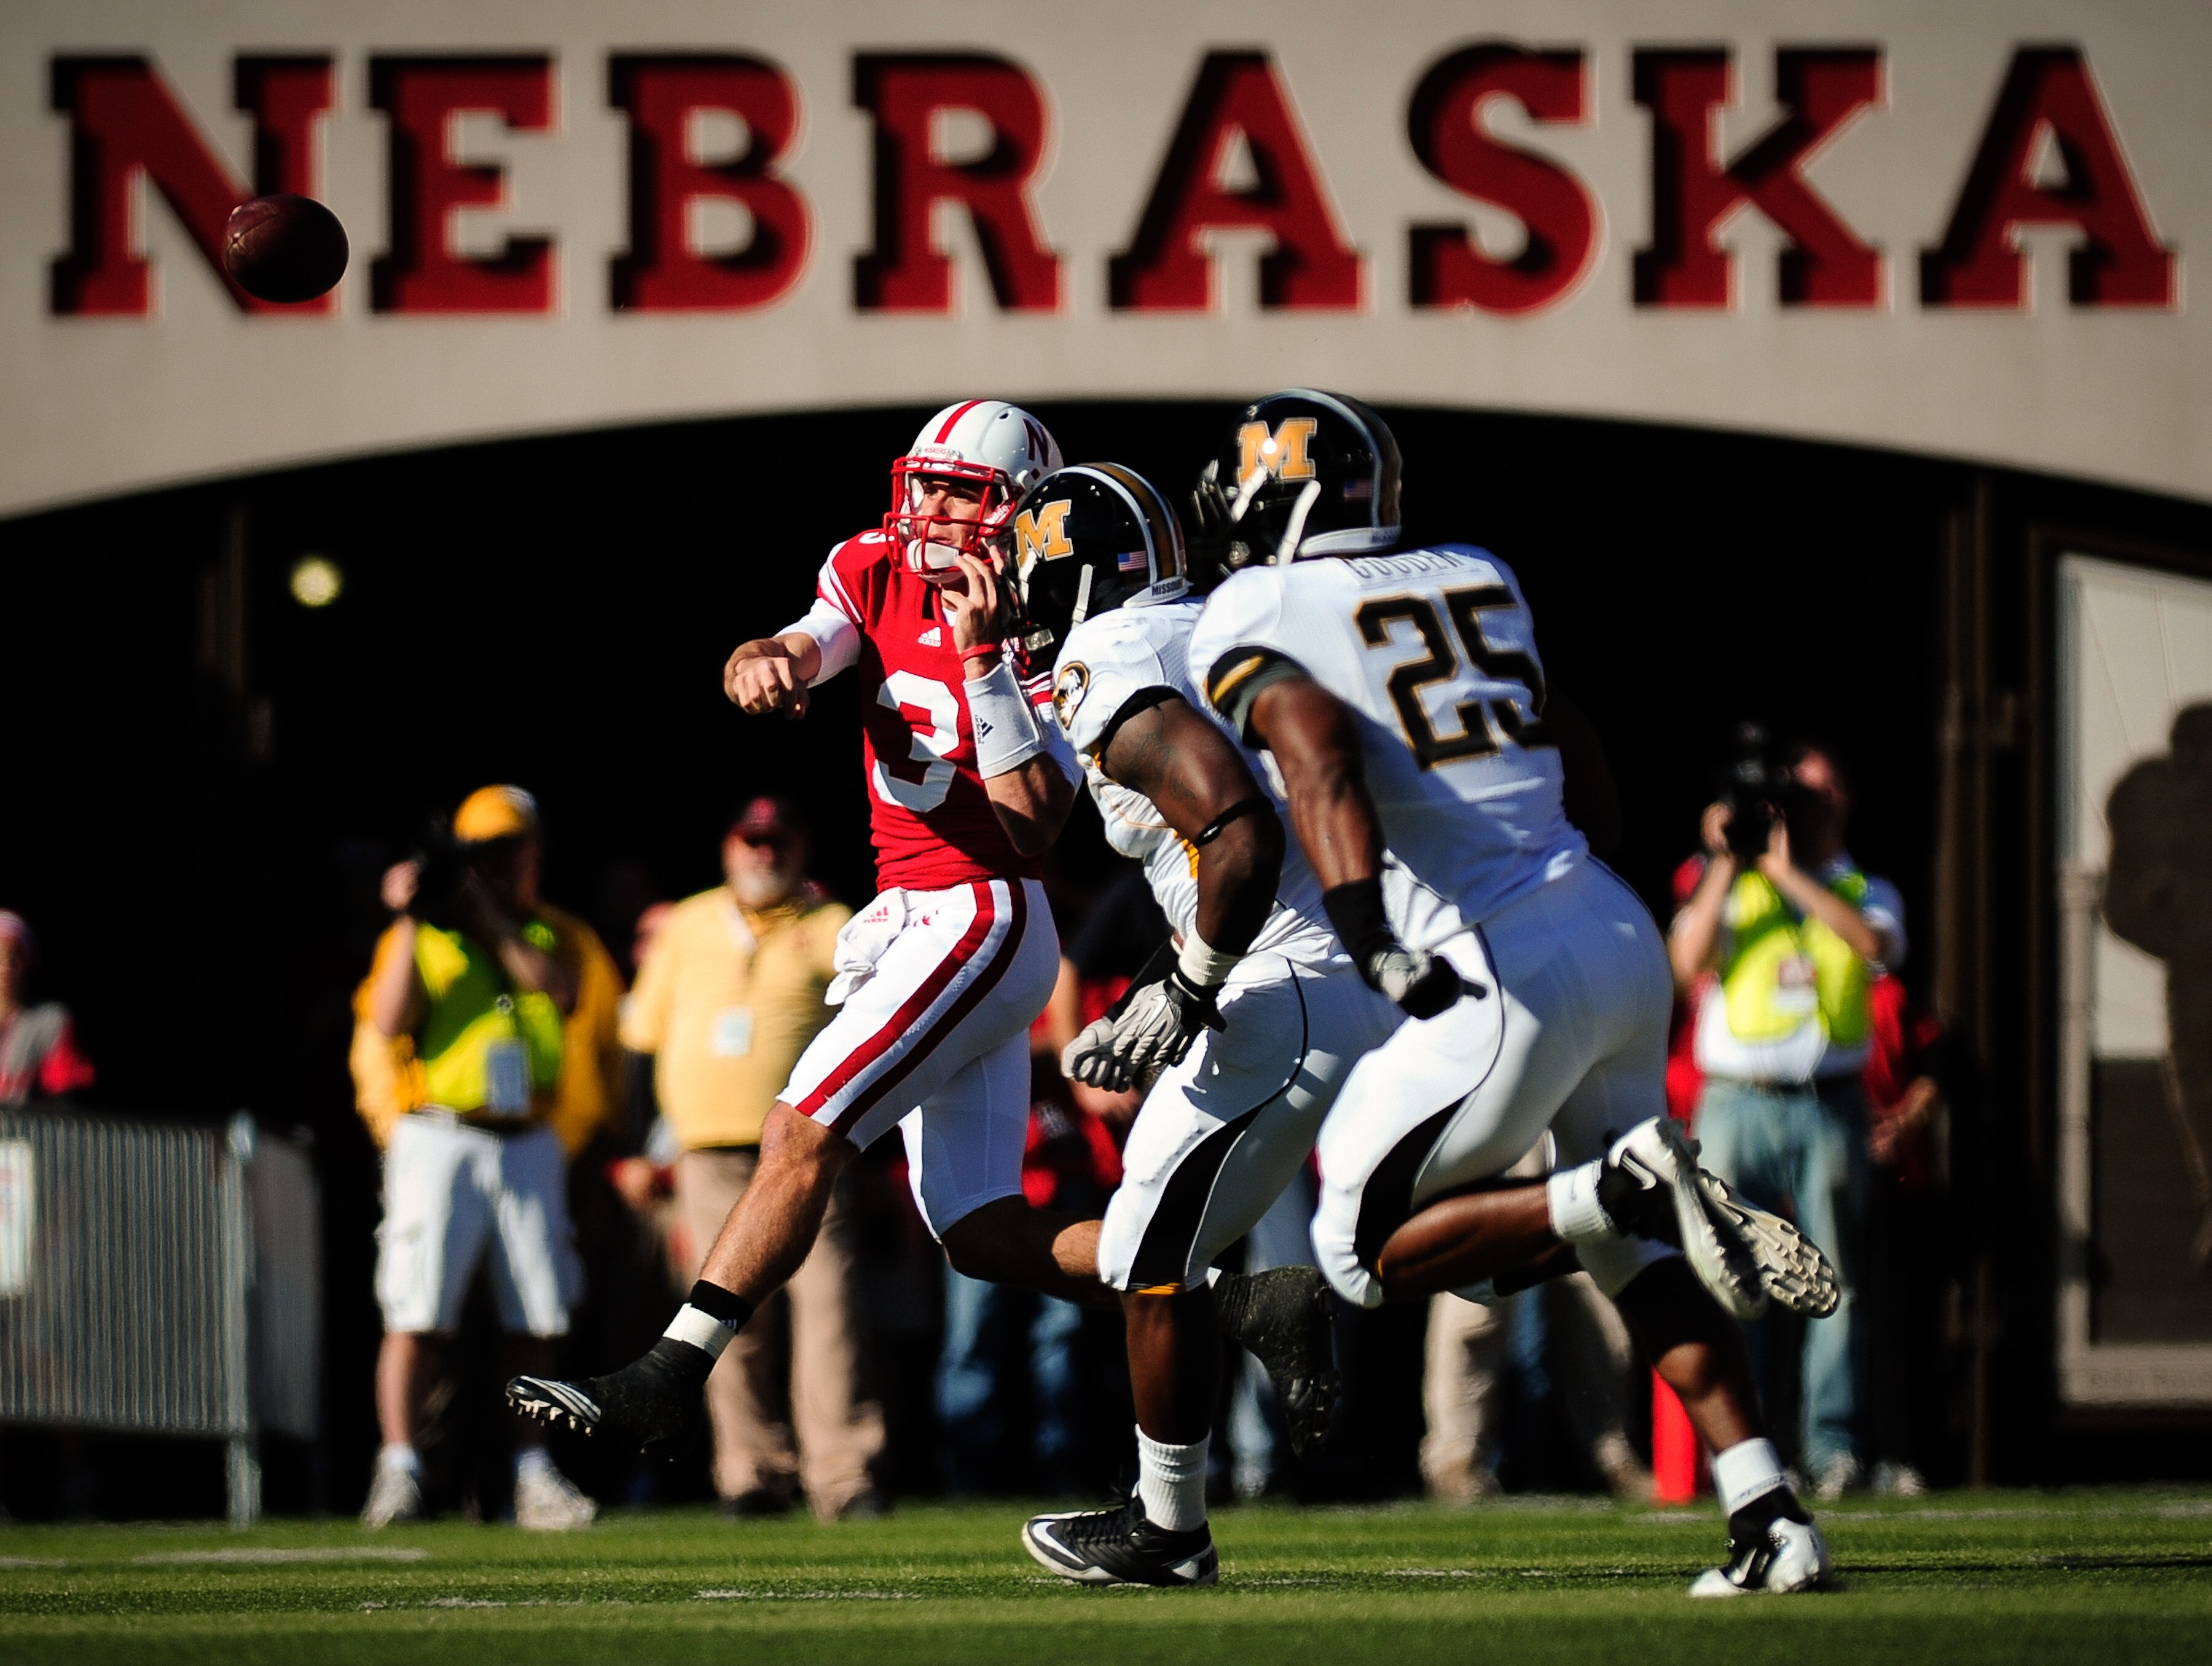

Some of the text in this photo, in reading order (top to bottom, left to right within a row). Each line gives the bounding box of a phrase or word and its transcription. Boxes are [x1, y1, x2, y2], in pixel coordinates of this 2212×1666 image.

[50, 37, 2180, 316] NEBRASKA
[1022, 418, 1049, 467] N
[1236, 417, 1317, 490] M
[1014, 499, 1074, 570] M
[1354, 583, 1547, 772] 25
[873, 669, 960, 813] 3
